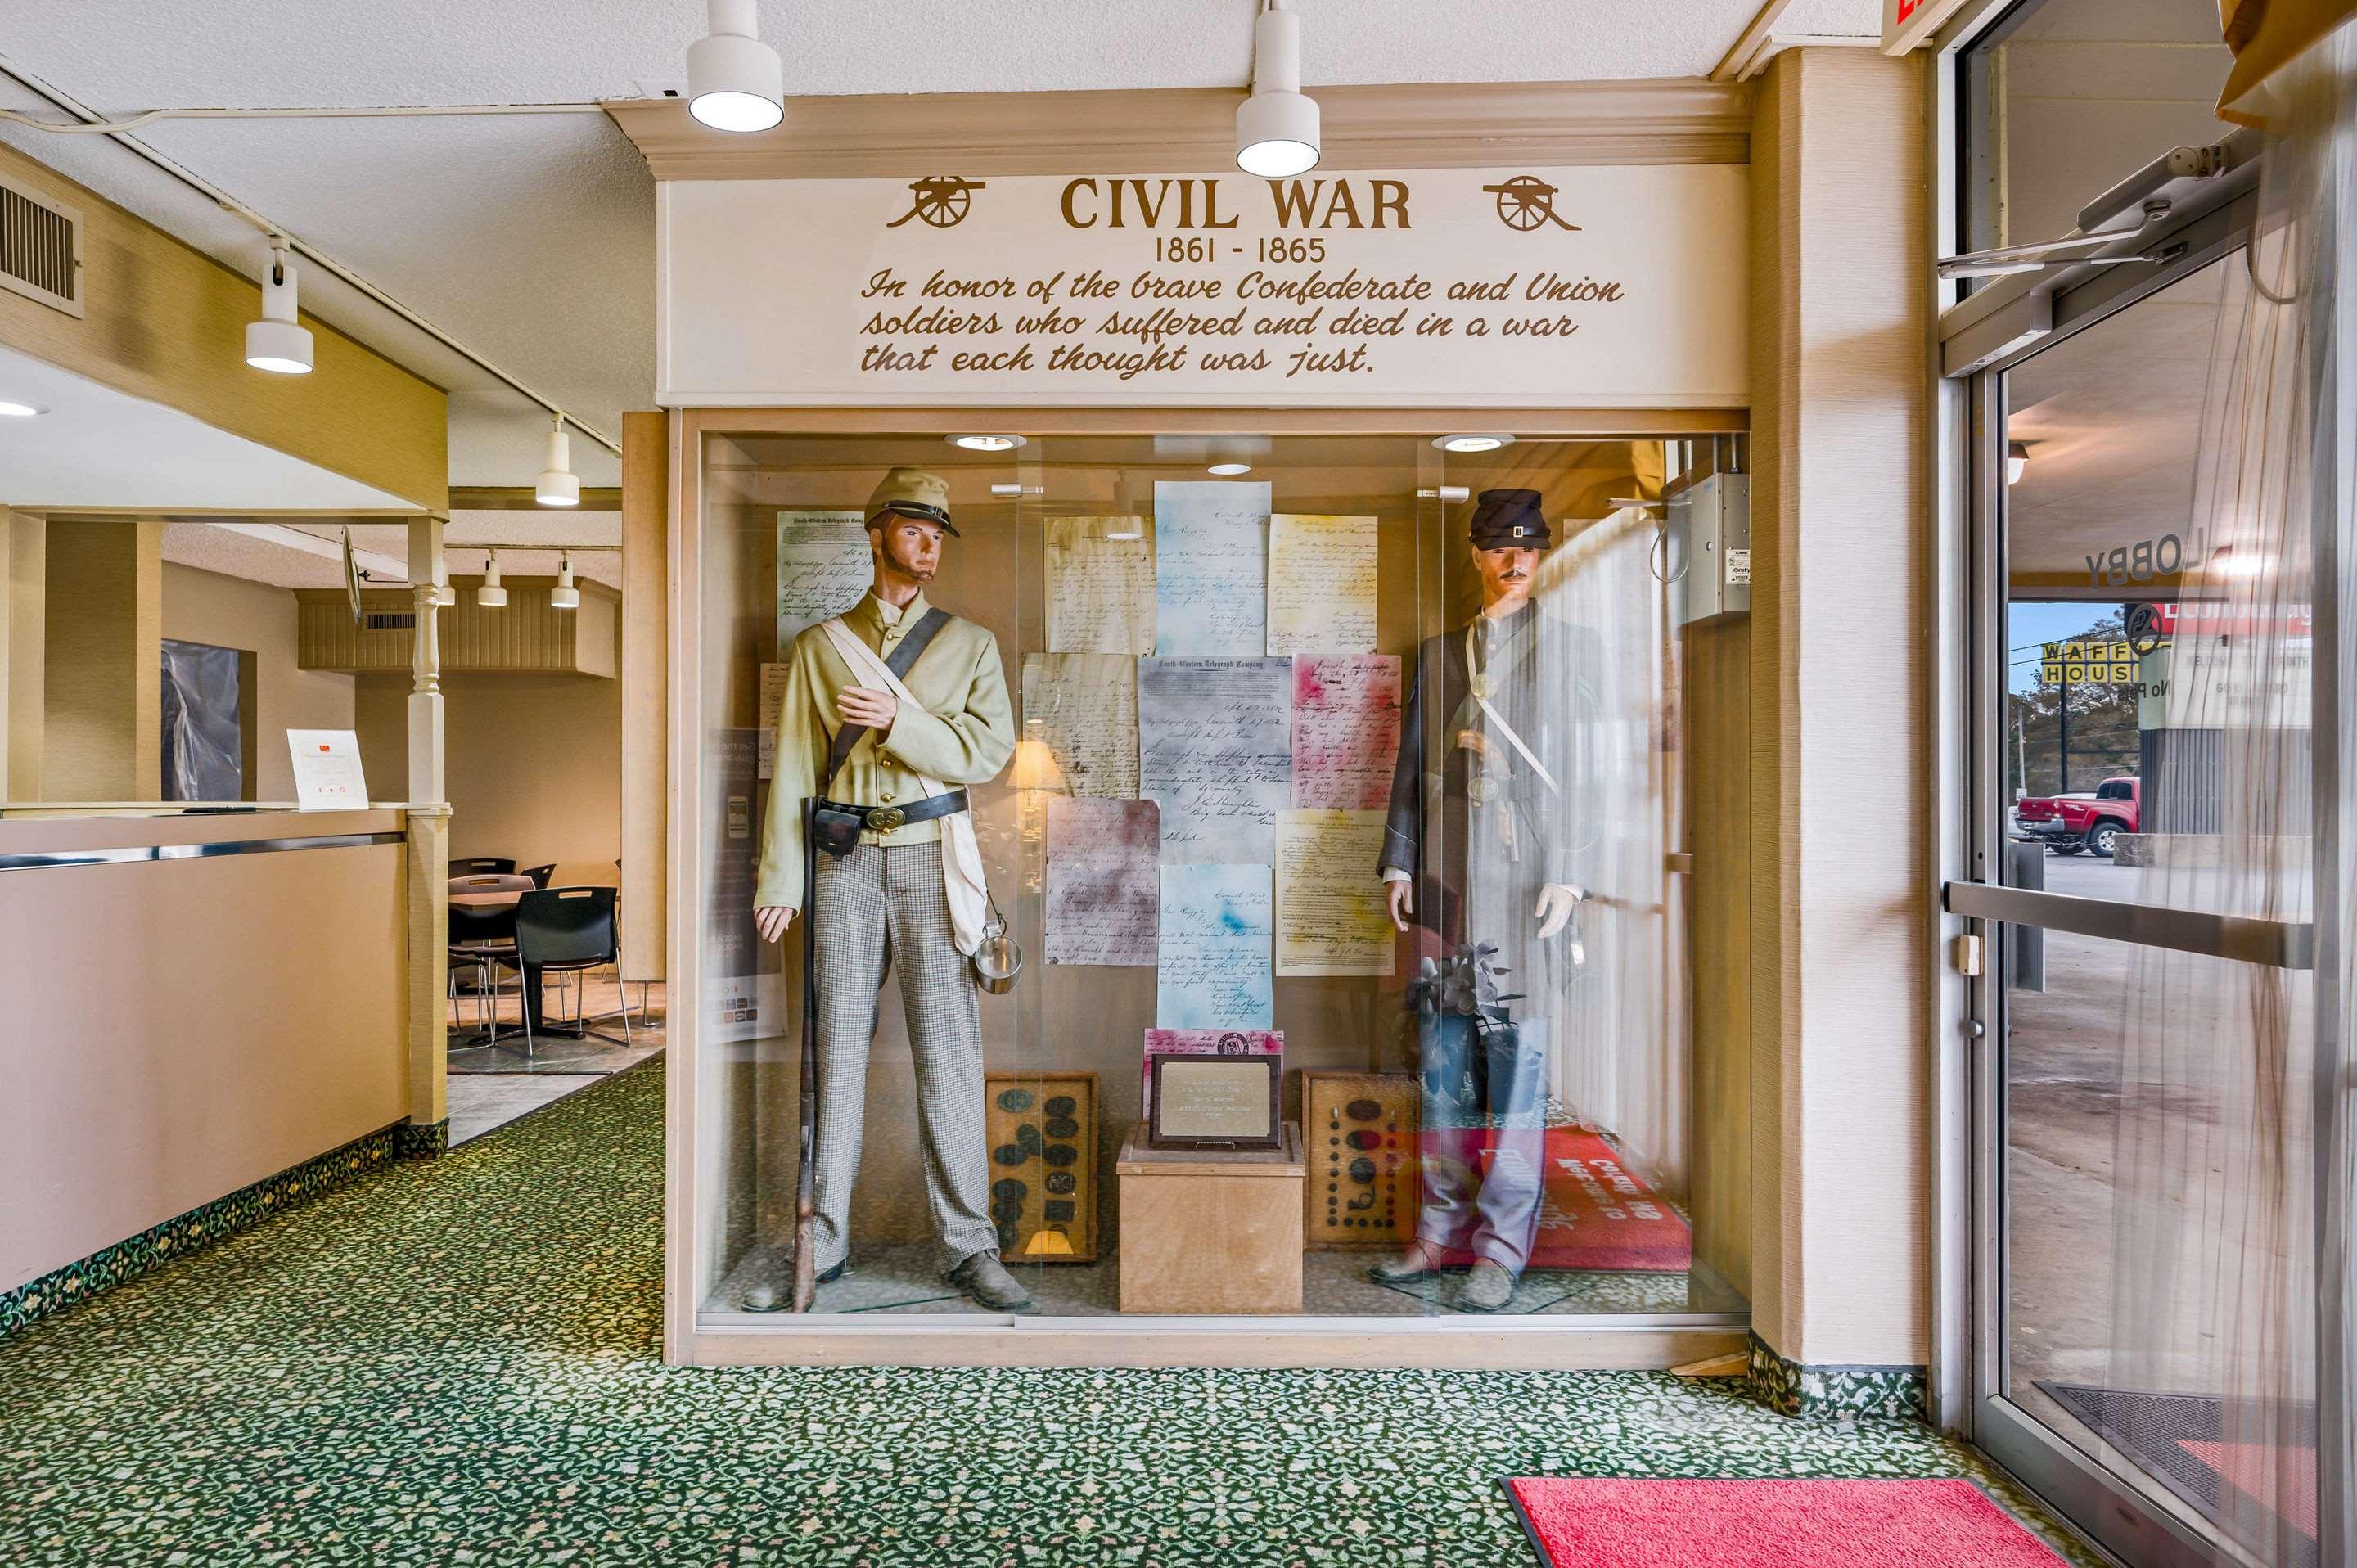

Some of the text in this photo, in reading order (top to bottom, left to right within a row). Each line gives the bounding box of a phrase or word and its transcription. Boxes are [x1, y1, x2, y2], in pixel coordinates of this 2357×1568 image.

[1061, 178, 1413, 229] CIVIL WAR
[1156, 237, 1214, 264] 1861
[1259, 237, 1326, 264] 1865
[860, 268, 1625, 307] In honor of the brave Confederate and Union
[859, 304, 1580, 345] soldiers who suffered and died in a war
[860, 342, 1373, 381] that each thought was just.
[2045, 645, 2127, 660] WAFF
[2047, 666, 2128, 681] HOUS
